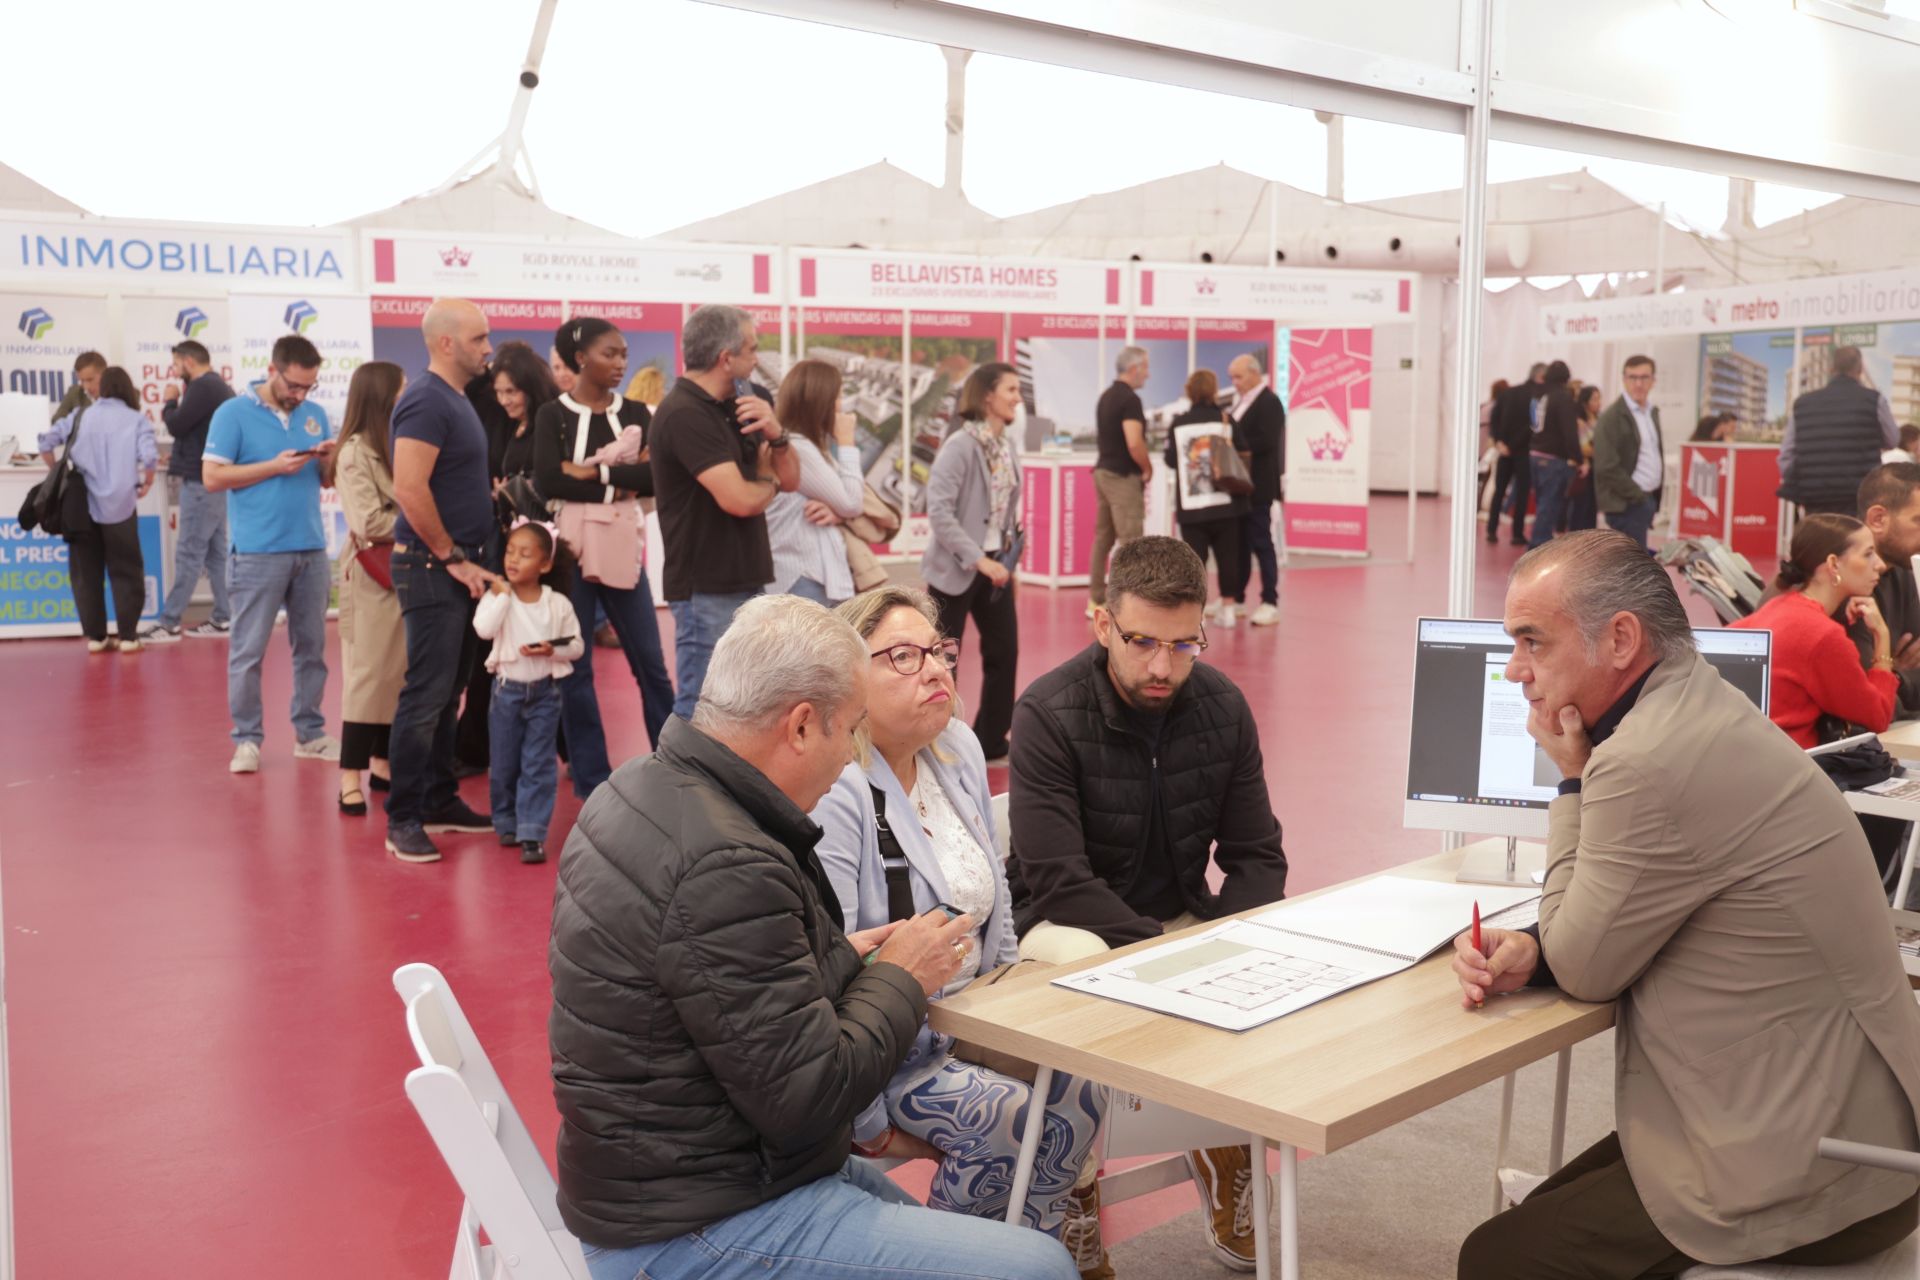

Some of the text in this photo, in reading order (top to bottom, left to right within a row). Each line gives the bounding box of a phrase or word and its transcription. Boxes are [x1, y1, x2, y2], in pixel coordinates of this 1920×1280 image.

[21, 235, 343, 279] INMOBILIARIA
[598, 257, 640, 269] HOME
[871, 263, 1057, 287] BELLAVISTA HOMES
[1731, 297, 1780, 322] metro
[1566, 315, 1599, 333] metro
